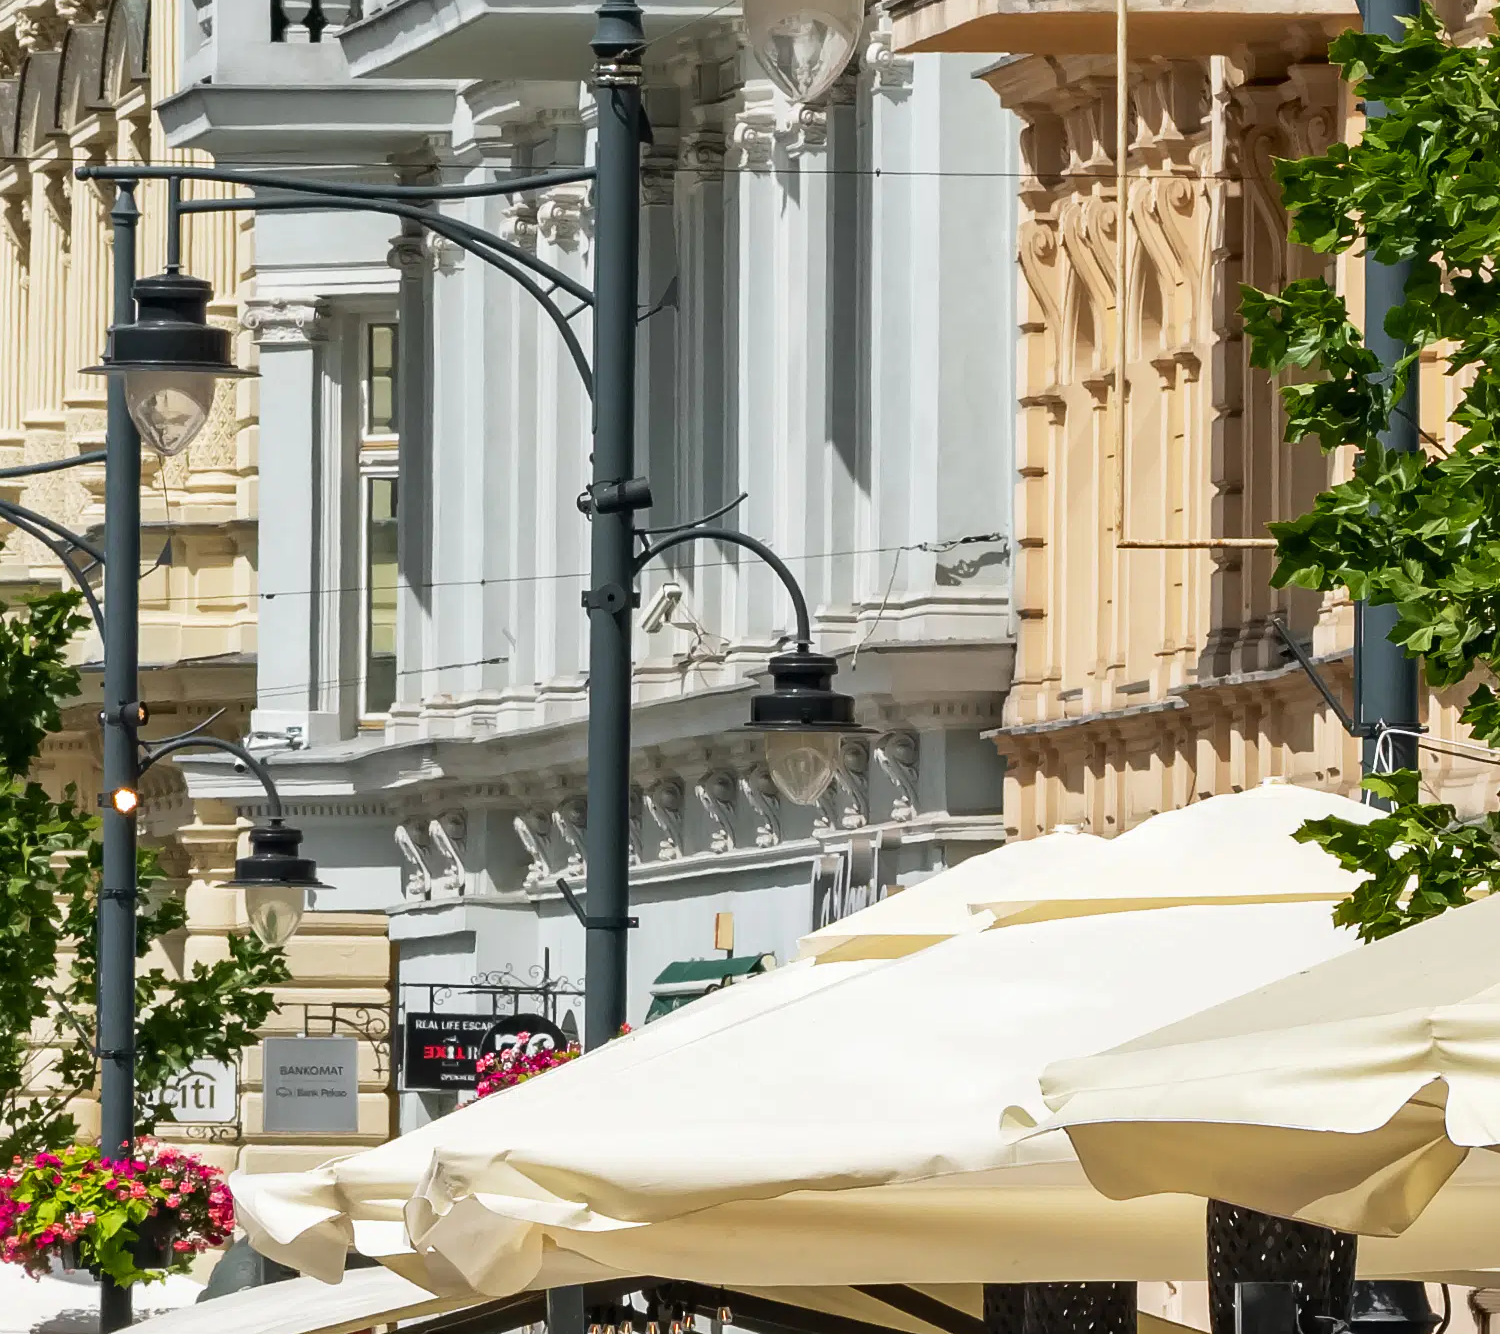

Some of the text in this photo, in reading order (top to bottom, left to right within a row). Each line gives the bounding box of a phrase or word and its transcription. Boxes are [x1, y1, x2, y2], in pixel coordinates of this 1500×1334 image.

[441, 1020, 460, 1030] LIFE
[462, 1021, 498, 1031] ESCAP
[280, 1065, 344, 1076] BANKOMAT
[158, 1076, 216, 1109] citi
